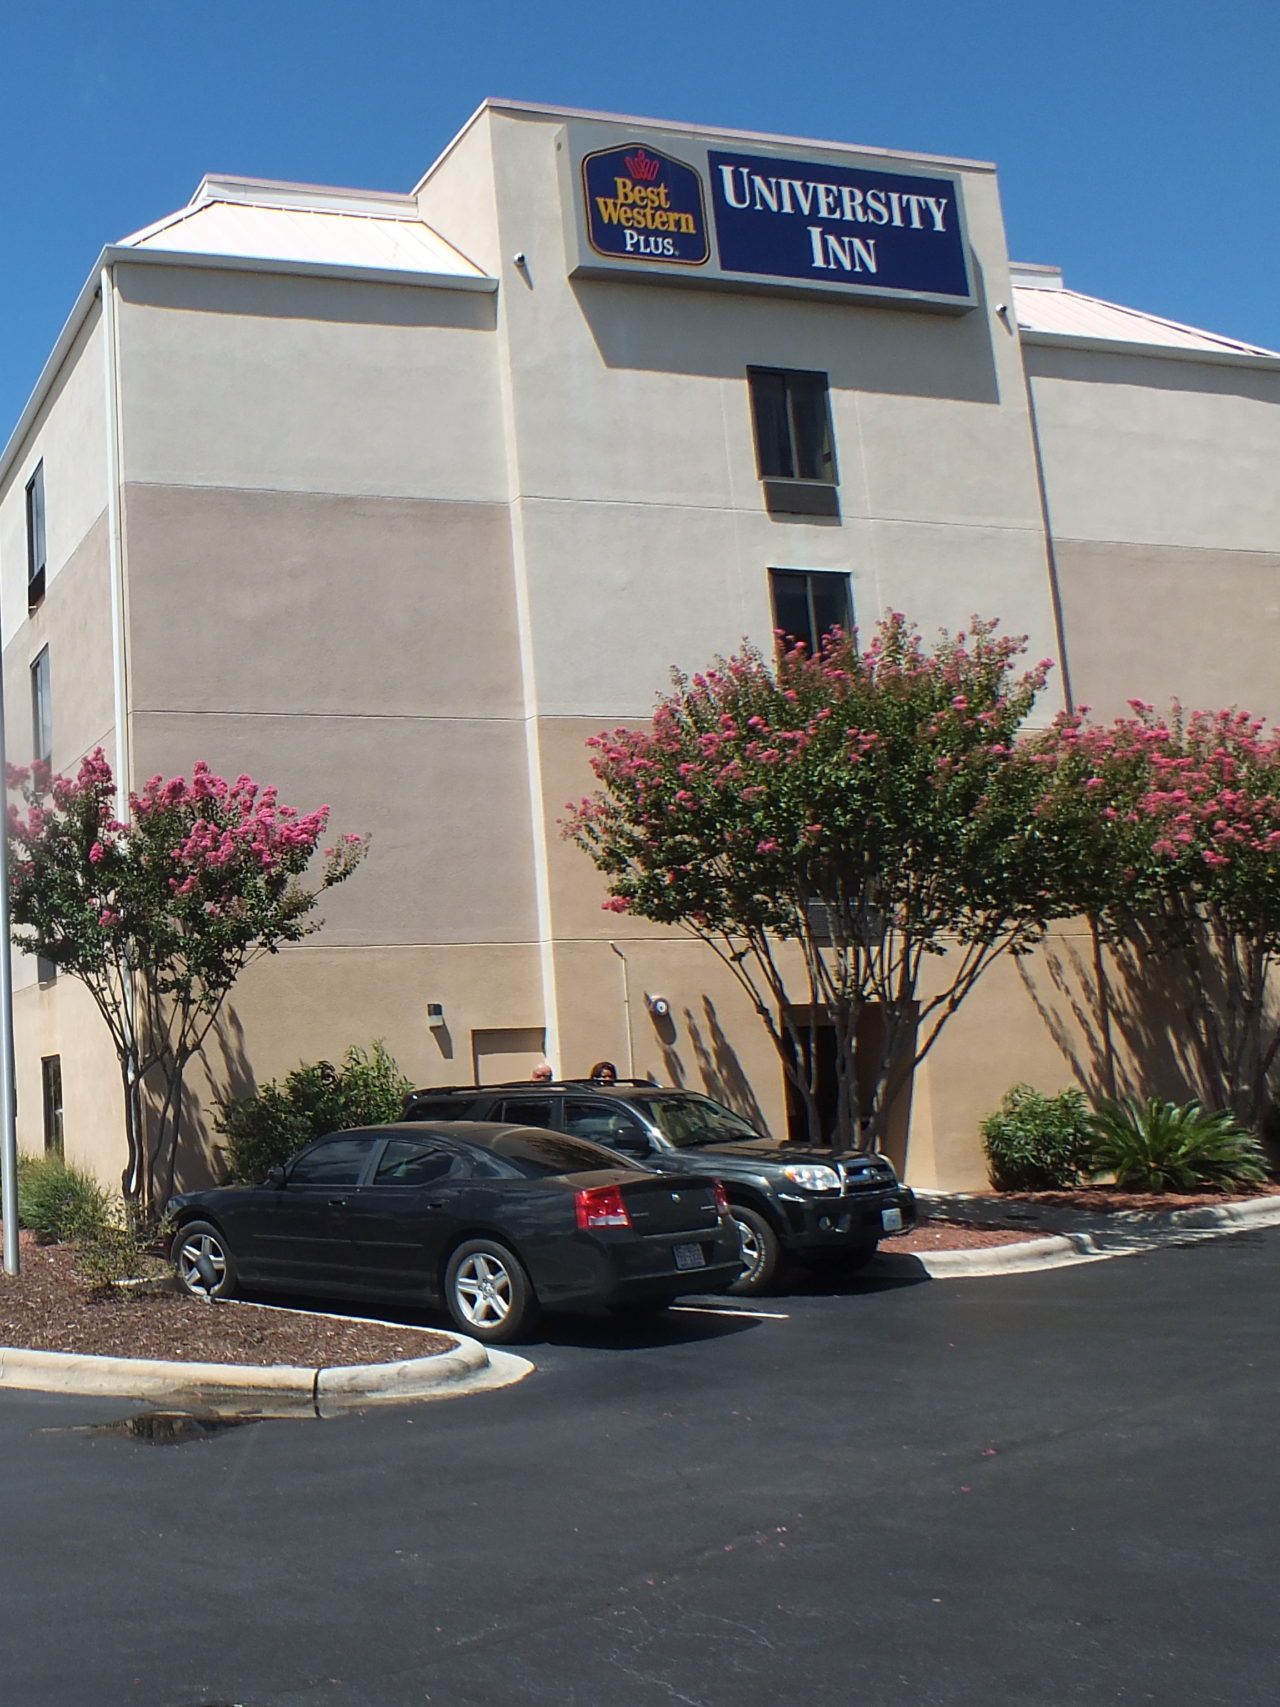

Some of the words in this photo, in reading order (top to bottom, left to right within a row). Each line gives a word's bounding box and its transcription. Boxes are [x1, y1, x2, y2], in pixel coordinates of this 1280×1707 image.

[614, 176, 670, 208] Best
[718, 165, 947, 232] UNIVERSITY
[595, 197, 696, 234] Western
[624, 229, 674, 256] PLUS
[807, 226, 877, 274] INN
